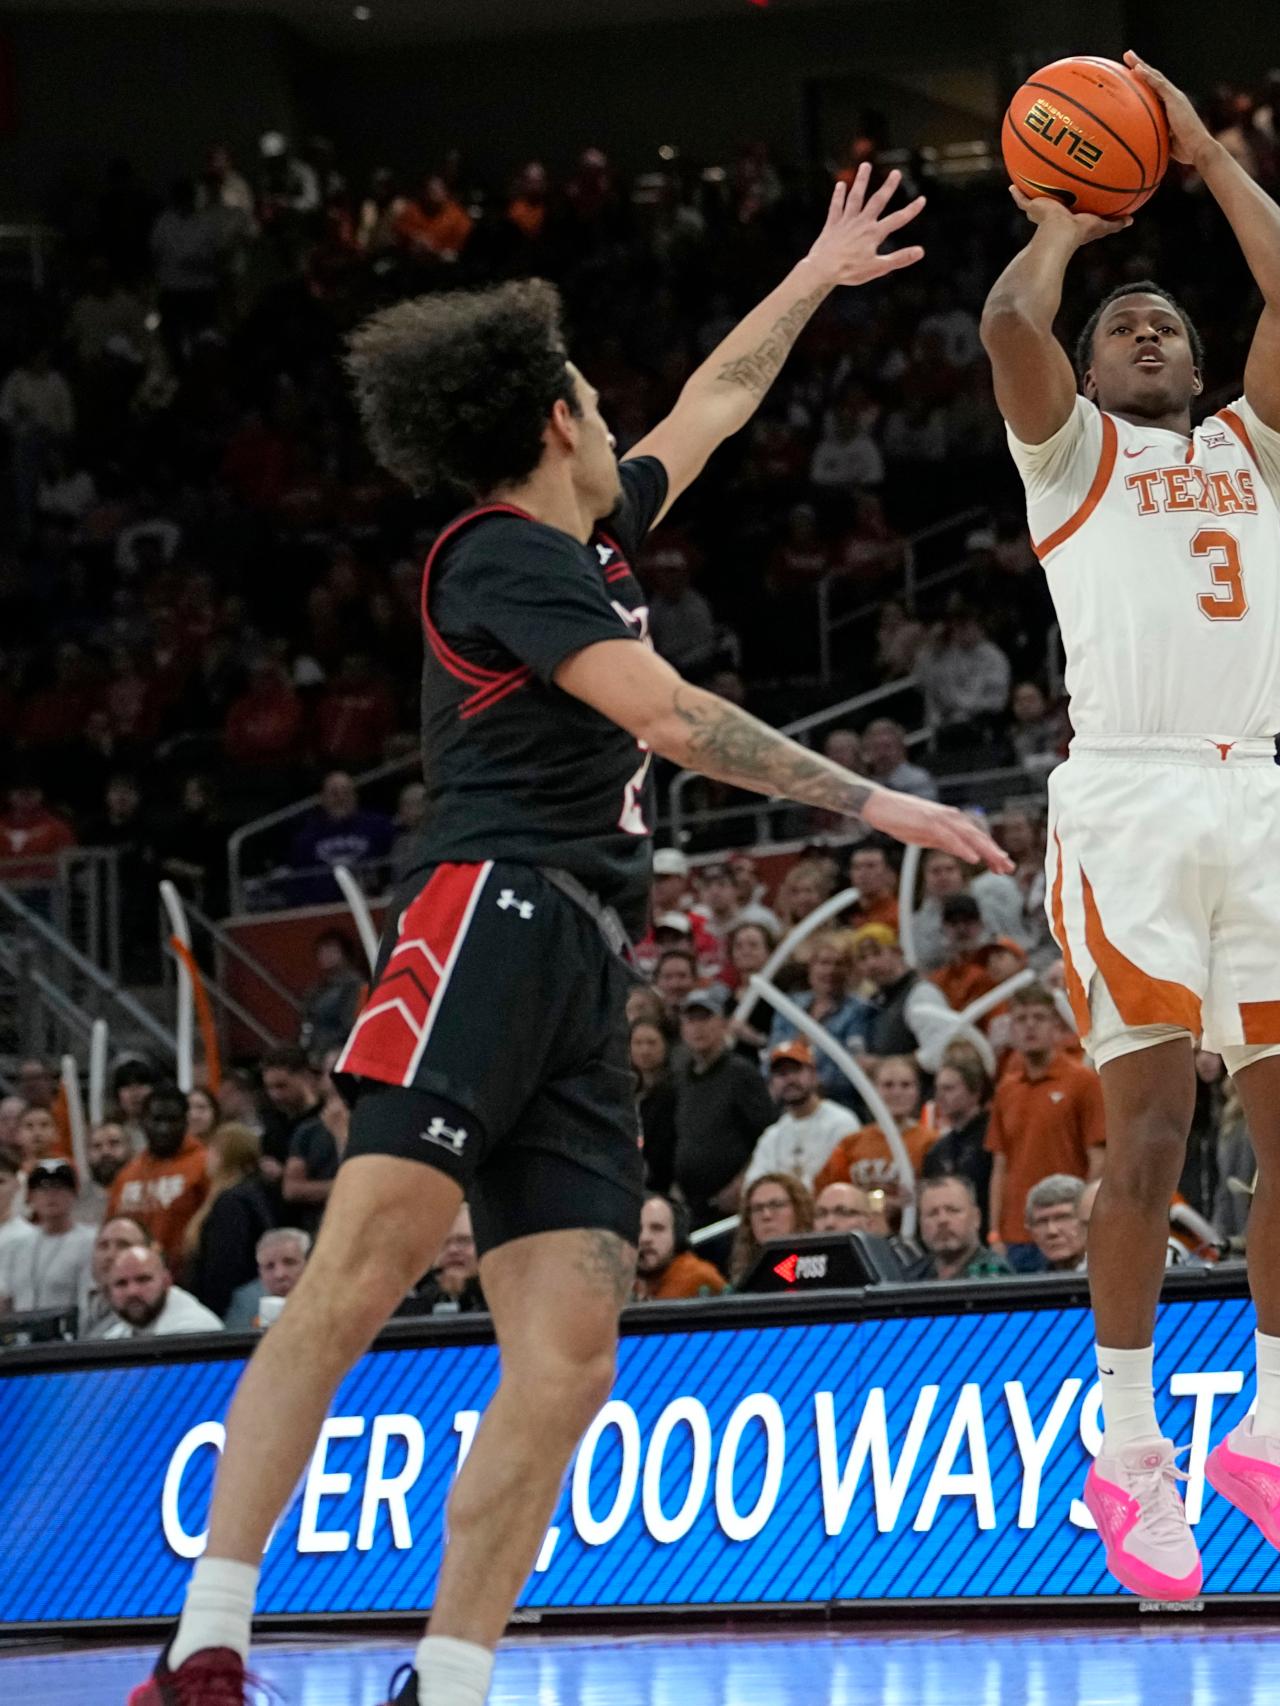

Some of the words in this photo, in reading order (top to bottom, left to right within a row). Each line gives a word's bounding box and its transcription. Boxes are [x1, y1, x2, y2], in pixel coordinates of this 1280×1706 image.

[1023, 101, 1104, 172] ELITE
[1124, 464, 1259, 517] TEXAS
[1189, 528, 1250, 622] 3
[161, 1412, 426, 1559] OER
[453, 1391, 786, 1572] ,000
